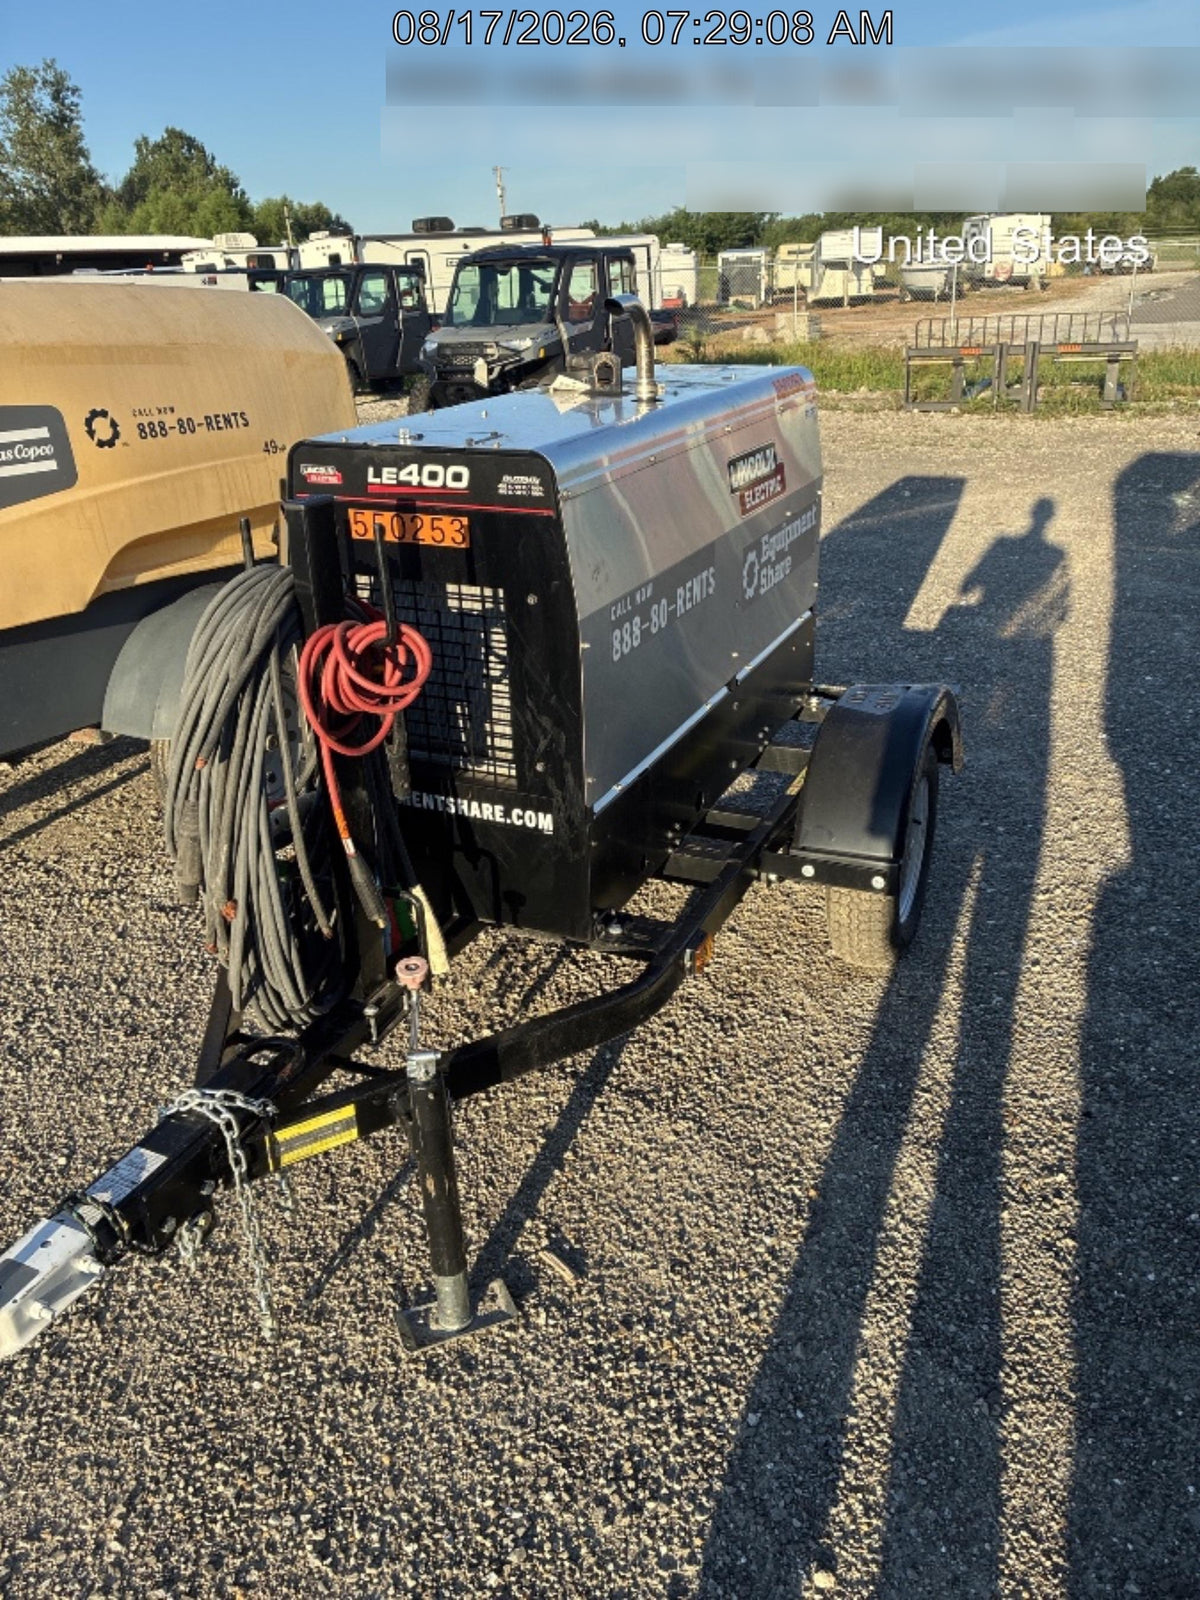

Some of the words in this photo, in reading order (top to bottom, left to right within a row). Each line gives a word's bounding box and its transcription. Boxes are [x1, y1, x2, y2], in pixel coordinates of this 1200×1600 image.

[137, 411, 250, 439] 888-80-RENTS
[14, 444, 54, 460] Copco
[367, 463, 470, 488] LE400
[760, 504, 817, 564] Equipment
[759, 555, 792, 595] Share
[610, 595, 631, 621] CALL
[612, 566, 716, 662] 888-80-RENTS
